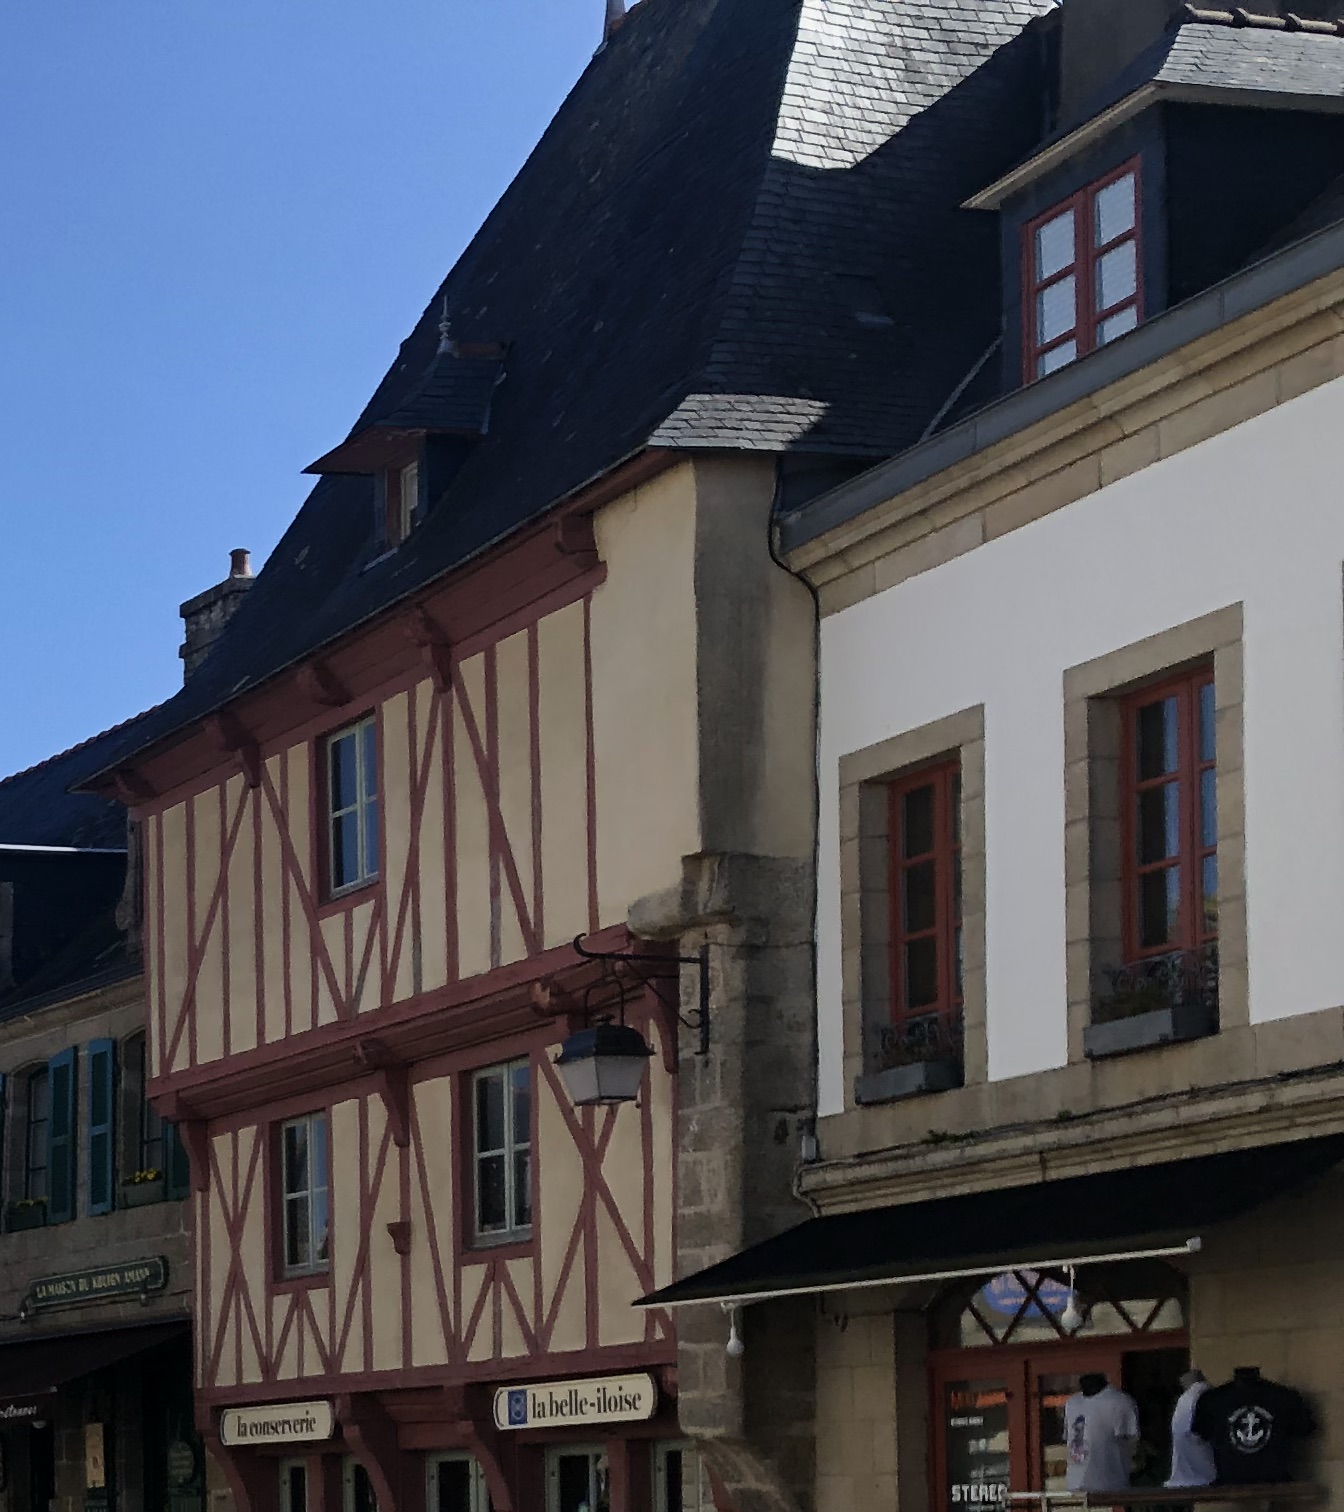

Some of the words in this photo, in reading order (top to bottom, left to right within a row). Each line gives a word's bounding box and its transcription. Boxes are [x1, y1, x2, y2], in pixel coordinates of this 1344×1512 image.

[532, 1392, 546, 1419] la
[549, 1385, 642, 1418] belle-iloise
[237, 1415, 247, 1438] la
[249, 1410, 317, 1437] conserverie
